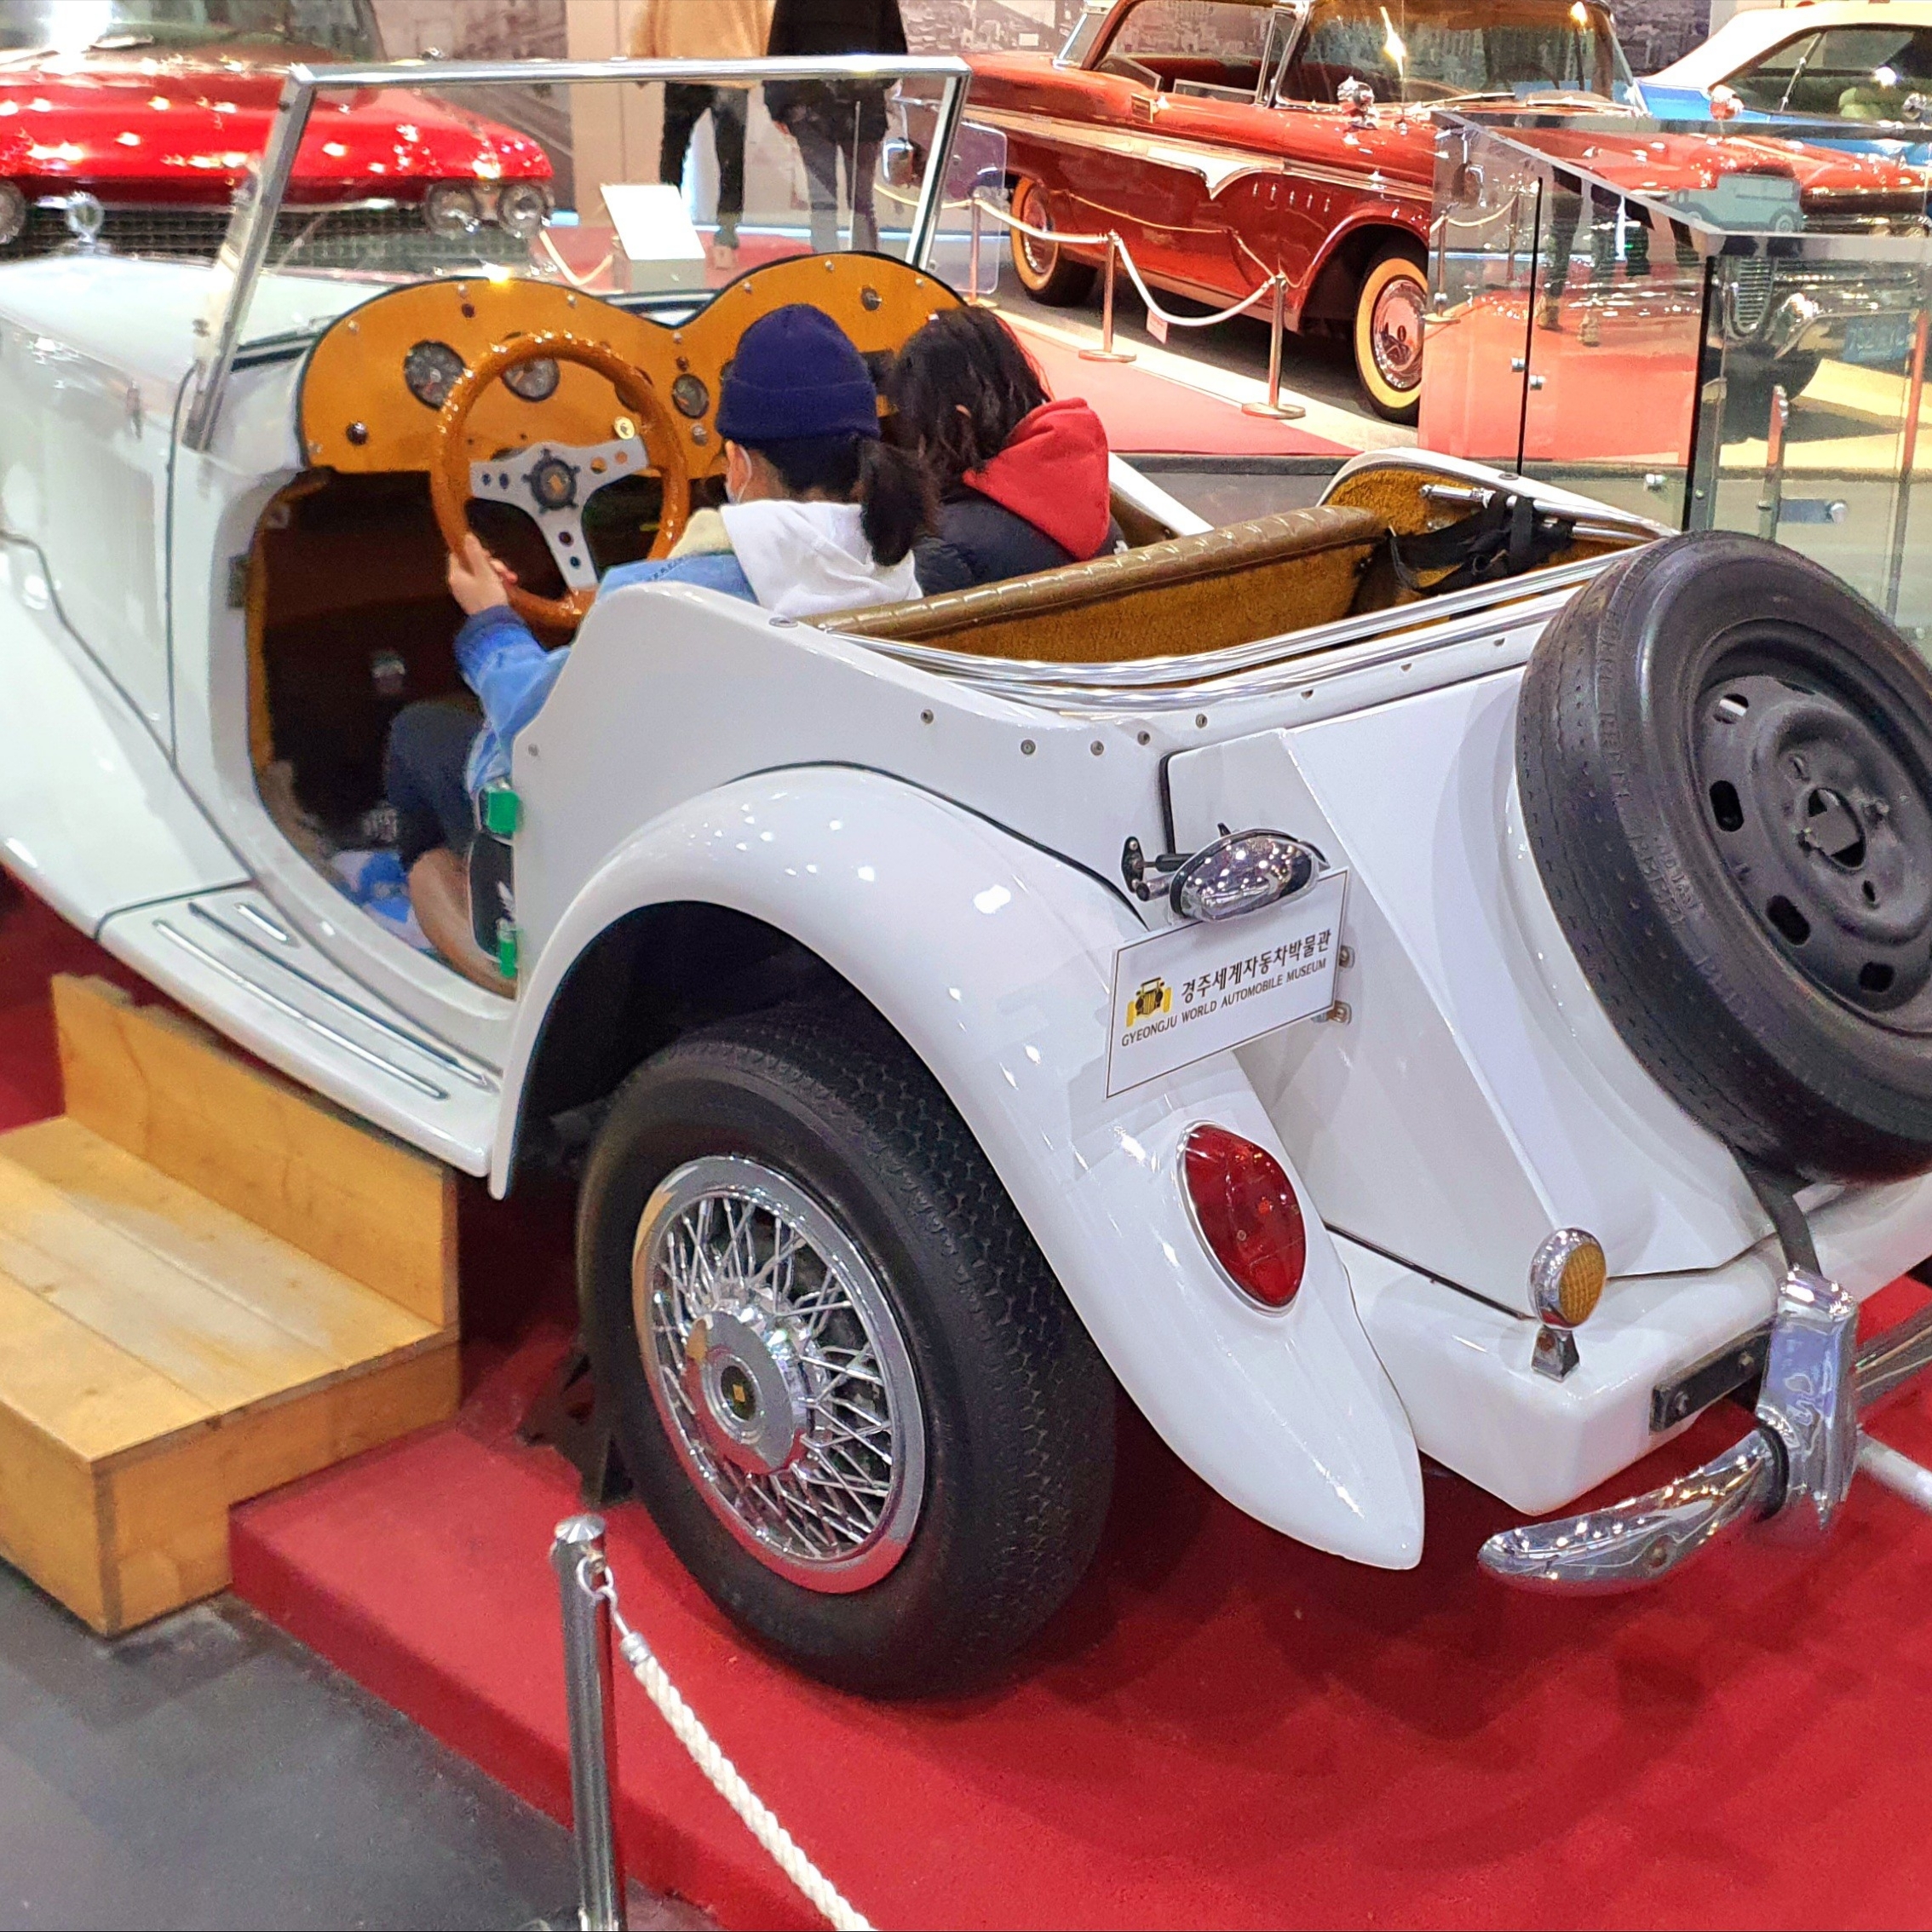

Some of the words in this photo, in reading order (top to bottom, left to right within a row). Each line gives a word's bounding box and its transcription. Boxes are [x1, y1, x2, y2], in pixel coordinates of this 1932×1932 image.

[1121, 1015, 1177, 1047] GYEONGJU
[1182, 1000, 1217, 1023] WORLD
[1221, 974, 1283, 1008] AUTOMOBILE
[1286, 957, 1326, 983] MUSEUM
[1182, 928, 1331, 1003] 경주세계자동차박물관
